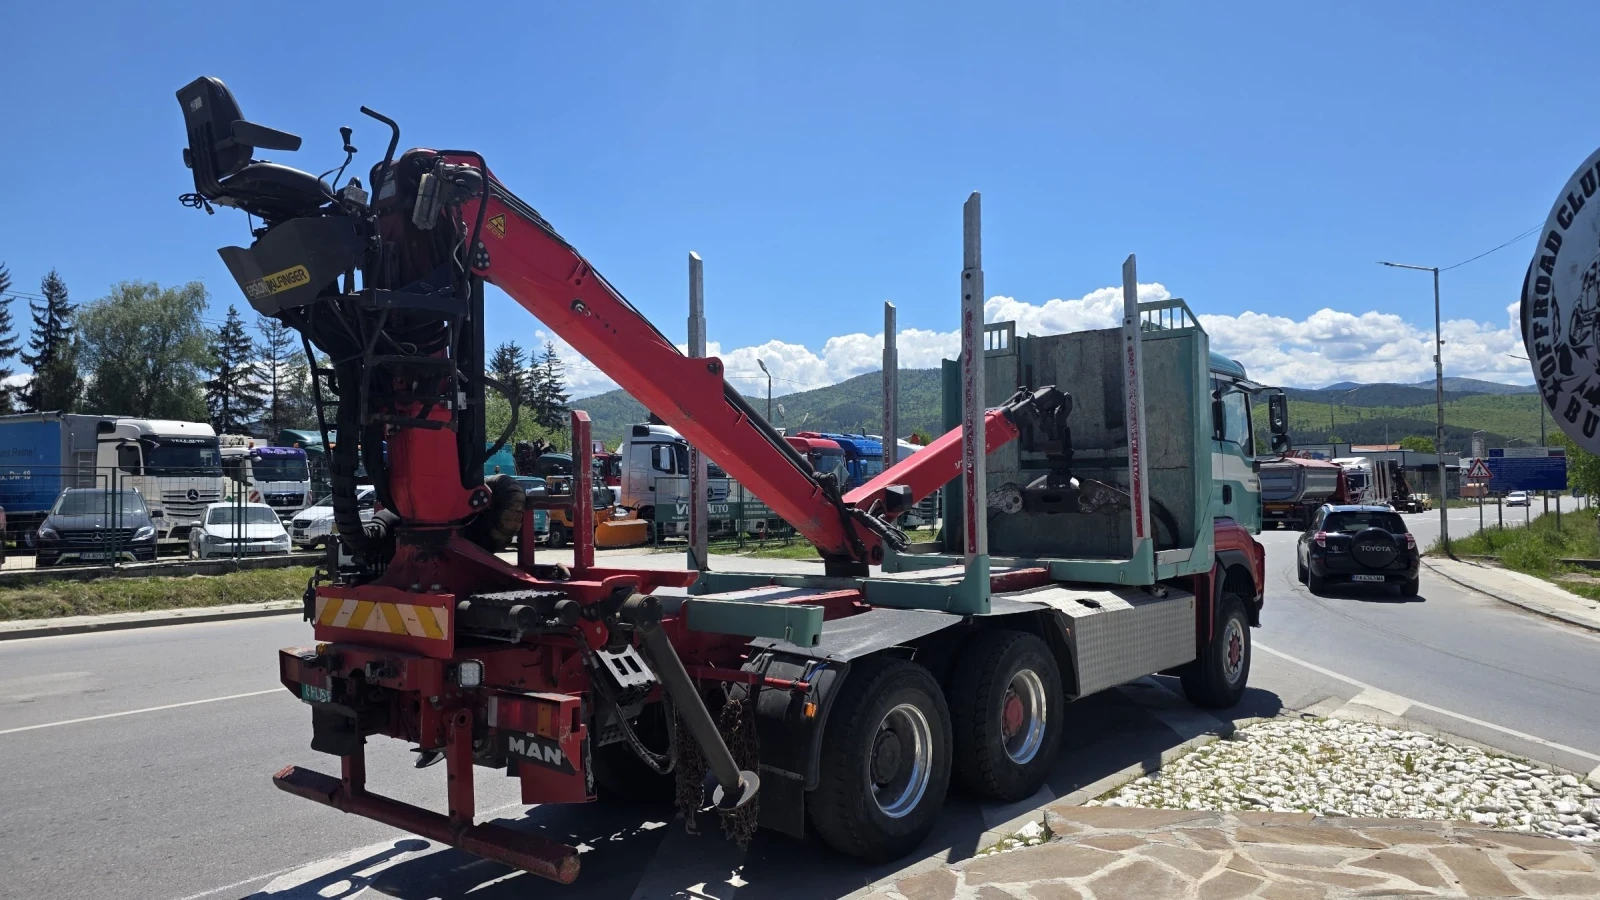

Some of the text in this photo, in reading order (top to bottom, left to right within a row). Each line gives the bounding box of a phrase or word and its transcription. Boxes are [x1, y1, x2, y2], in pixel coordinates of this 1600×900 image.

[265, 268, 308, 292] PALFINGER
[1532, 160, 1600, 379] OFFROAD CLU
[508, 736, 562, 766] MAN
